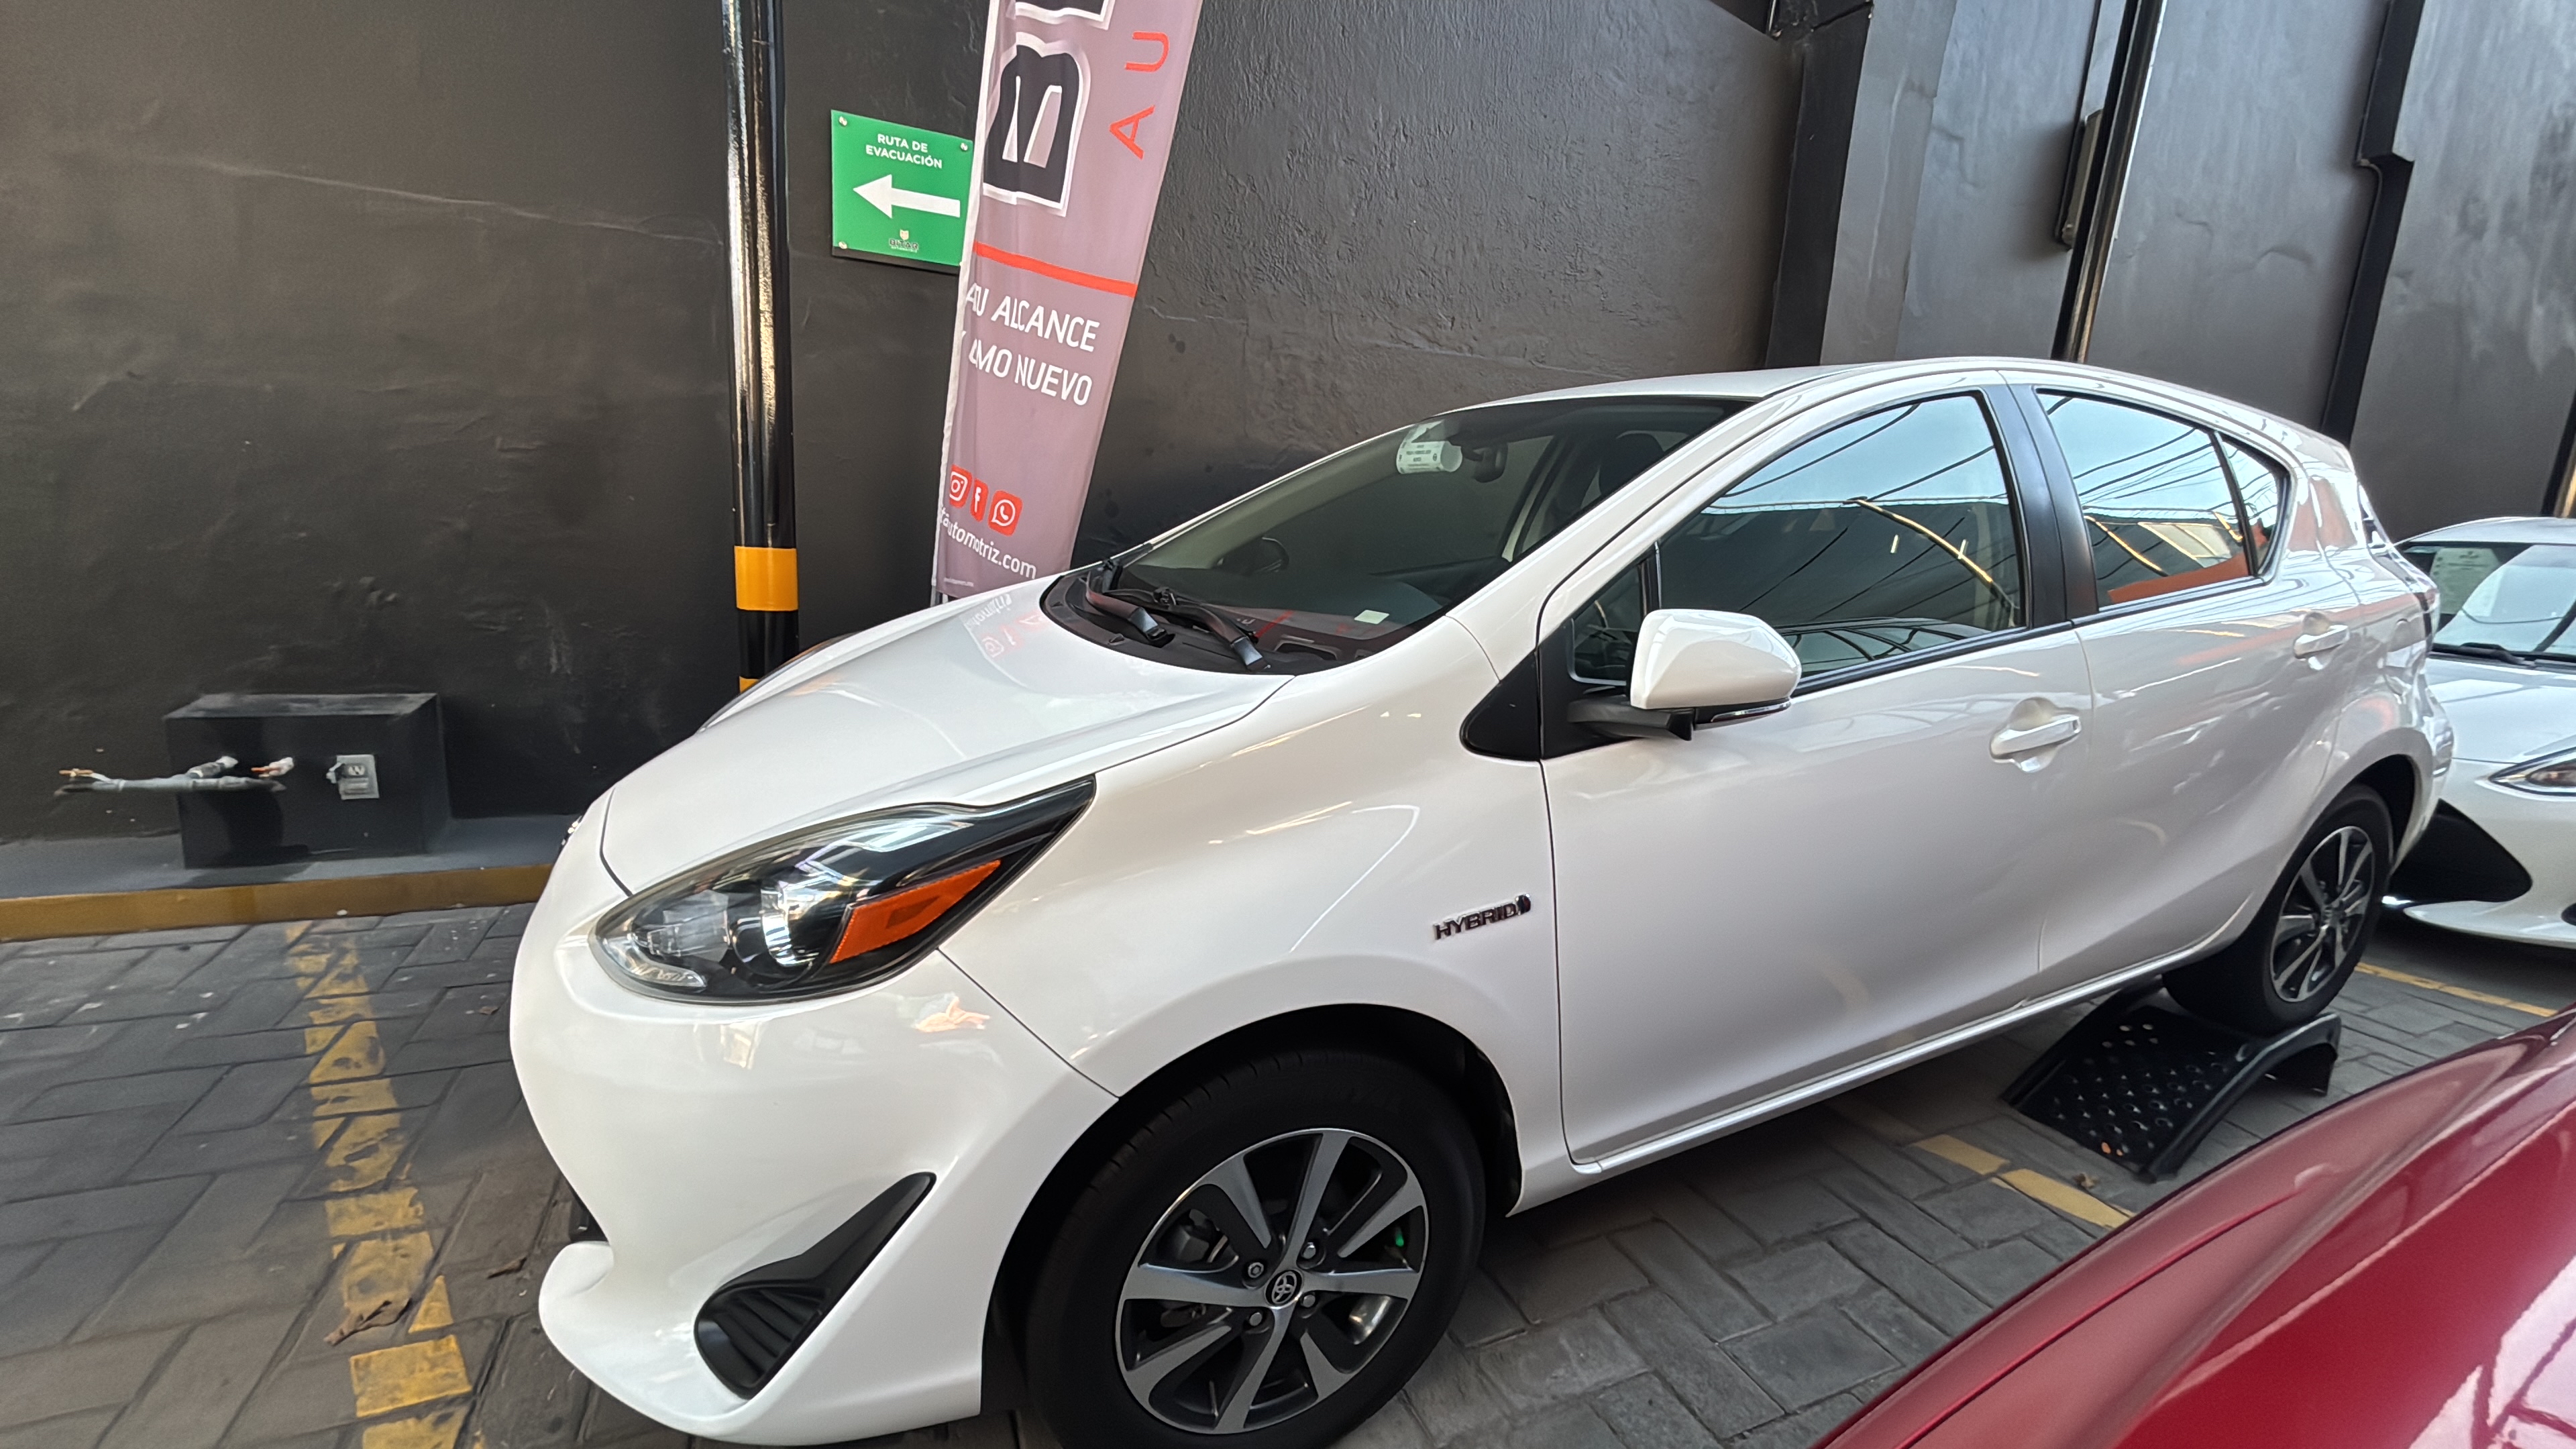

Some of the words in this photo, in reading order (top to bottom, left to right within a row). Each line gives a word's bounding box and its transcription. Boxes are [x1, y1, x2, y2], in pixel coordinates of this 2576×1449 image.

[865, 145, 943, 169] EVACUACIÓN
[877, 133, 909, 149] RUTA
[912, 140, 928, 153] DE
[991, 295, 1100, 352] ALCANCE
[1014, 354, 1092, 406] NUEVO
[1432, 902, 1517, 940] HYBRID
